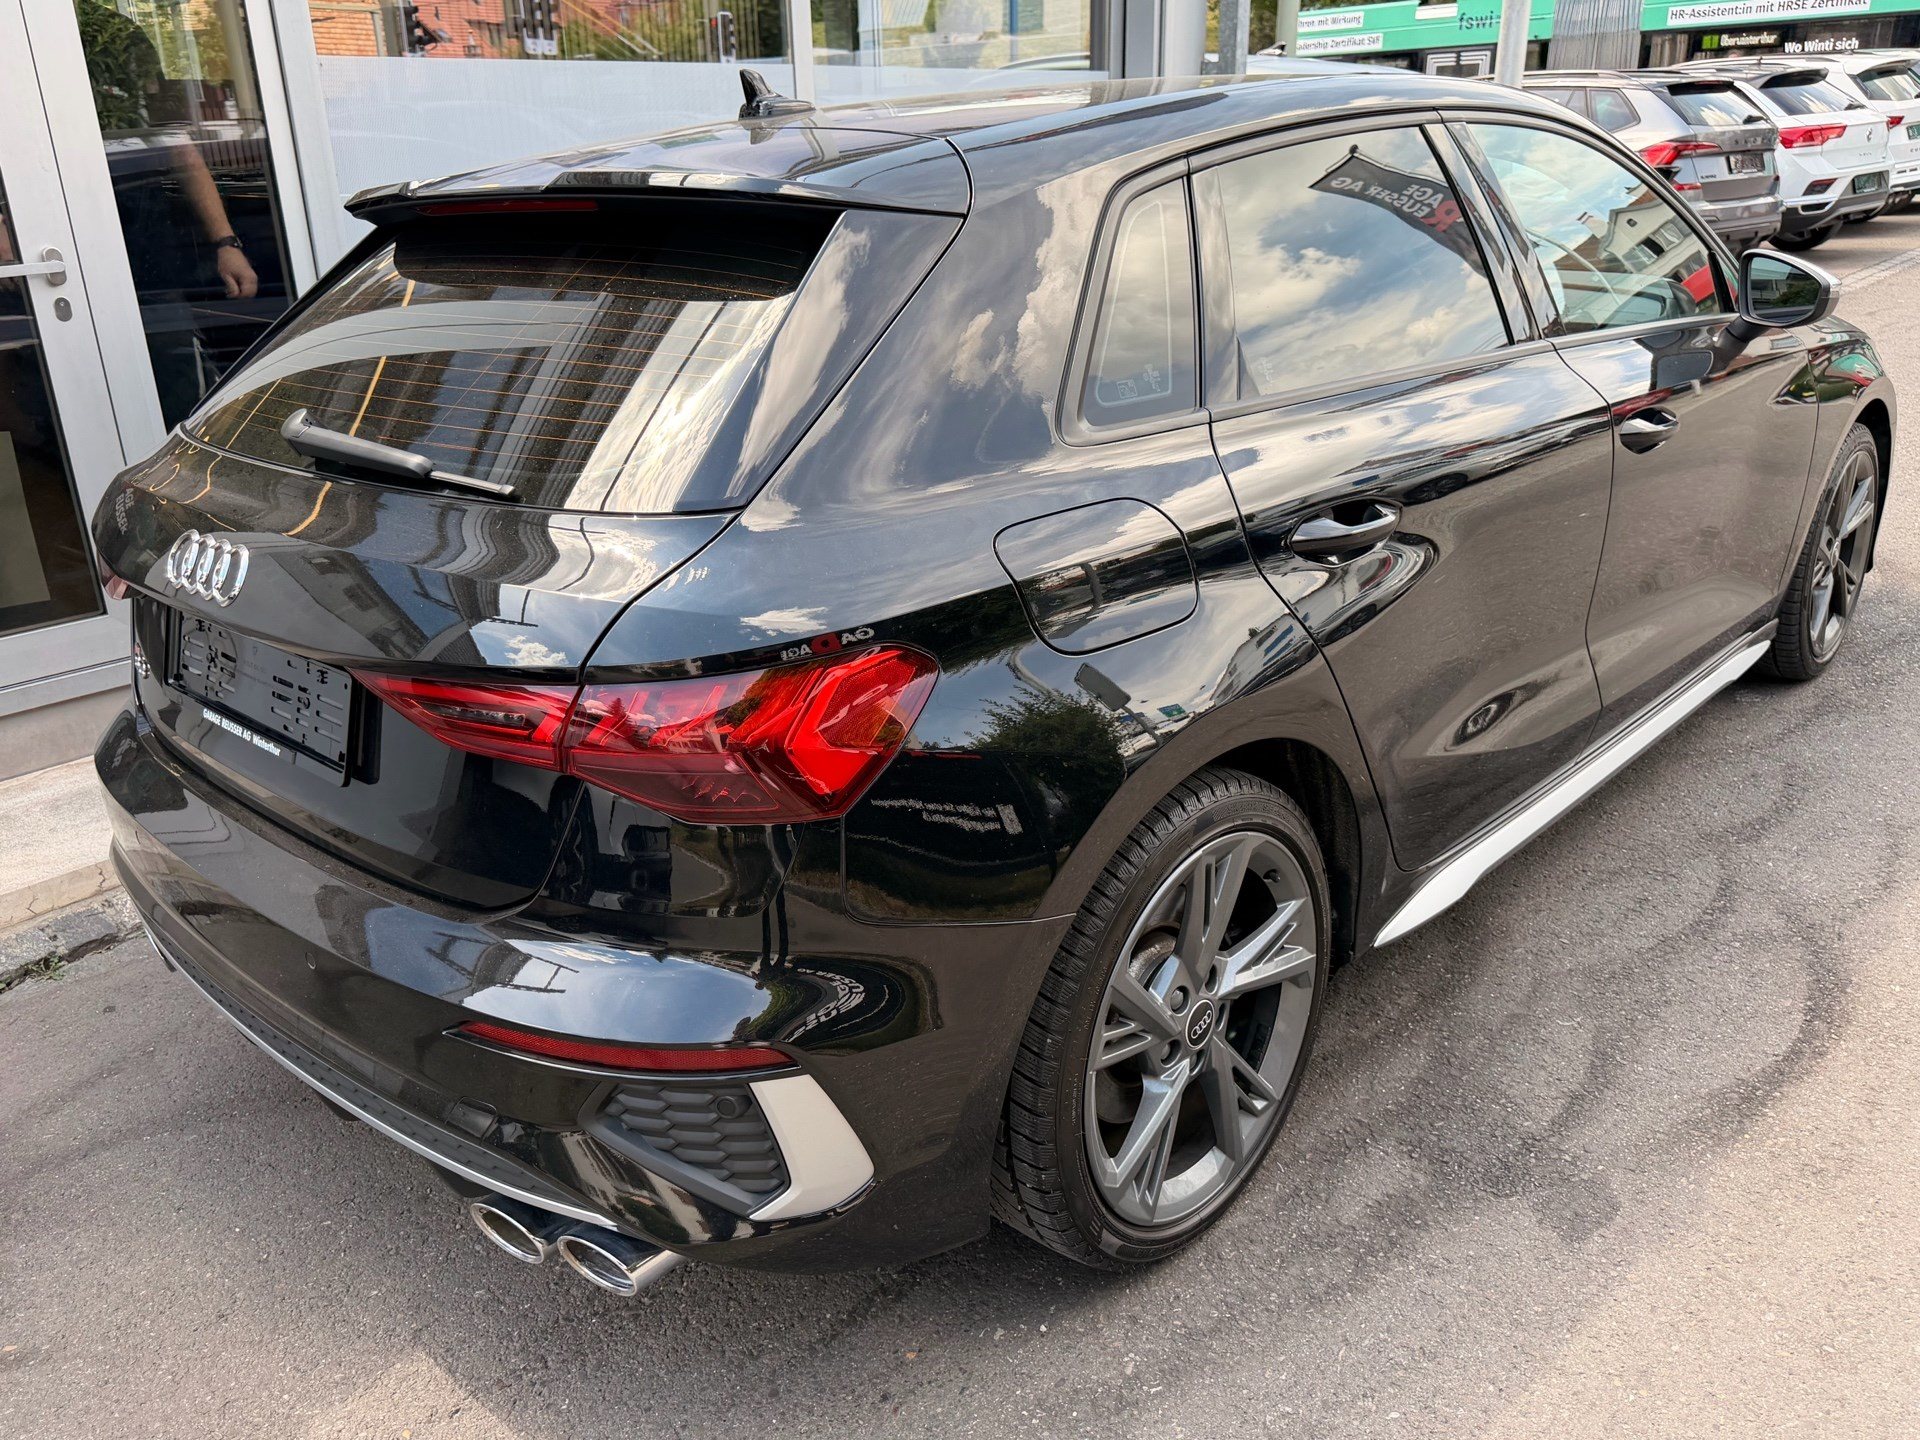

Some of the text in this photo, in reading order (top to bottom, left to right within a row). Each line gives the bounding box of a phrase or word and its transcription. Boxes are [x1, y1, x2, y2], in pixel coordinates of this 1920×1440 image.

[1670, 2, 1752, 20] HR-Assistent:in
[1755, 1, 1774, 14] mit
[1777, 0, 1808, 11] HRSE
[1784, 37, 1860, 53] Wo Winti sich
[203, 708, 281, 756] GARAGE REUSSER AG Winterthur
